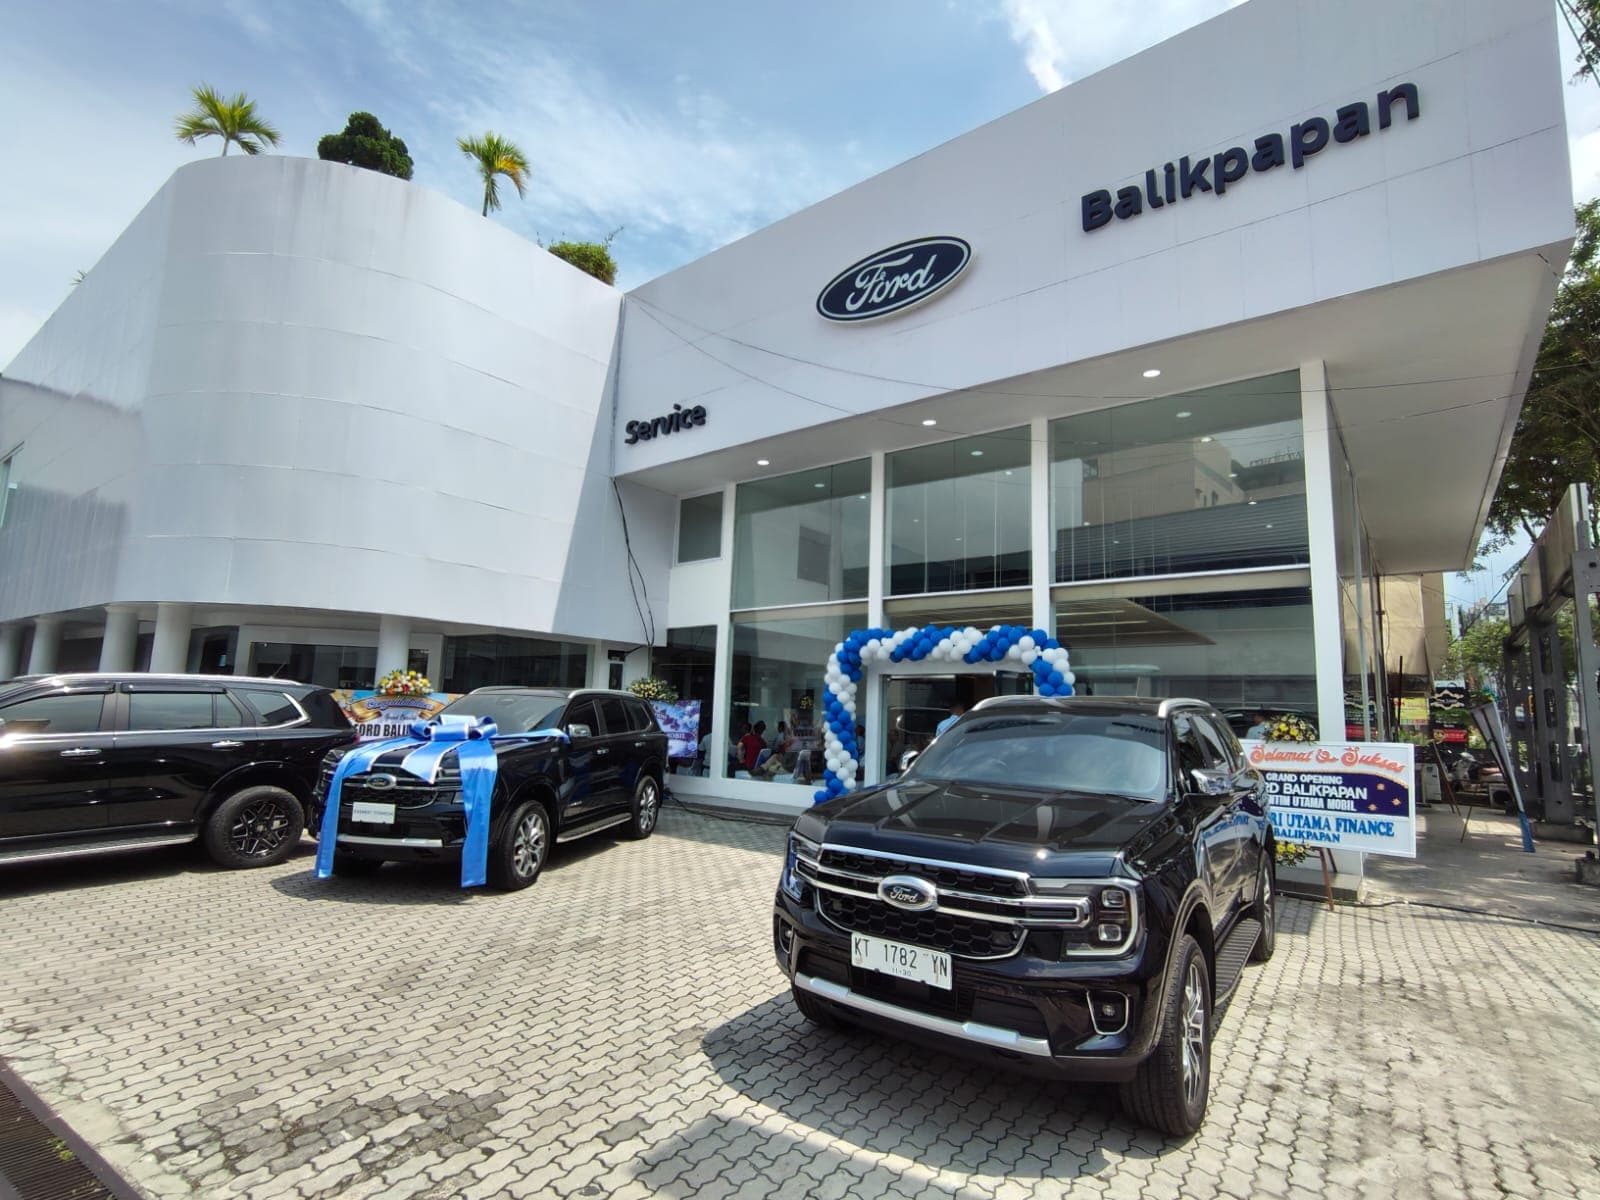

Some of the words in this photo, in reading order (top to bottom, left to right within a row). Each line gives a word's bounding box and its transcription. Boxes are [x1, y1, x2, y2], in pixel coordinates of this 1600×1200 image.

[1081, 82, 1420, 233] Balikpapan
[845, 253, 937, 311] Ford
[624, 403, 707, 445] Service
[1250, 744, 1314, 763] Selamat
[1266, 773, 1297, 783] GRAND
[1301, 774, 1343, 785] OPENING
[1283, 783, 1368, 800] BALIKPAPAN
[1293, 796, 1325, 809] UTAMA
[1327, 798, 1357, 812] MOBIL
[1274, 827, 1341, 843] BALIKPAPAN
[1286, 813, 1331, 832] UTAMA
[1336, 817, 1395, 838] FINANCE
[890, 886, 920, 903] Ford
[854, 936, 870, 958] KT
[883, 943, 918, 969] 1782
[931, 953, 948, 977] YN
